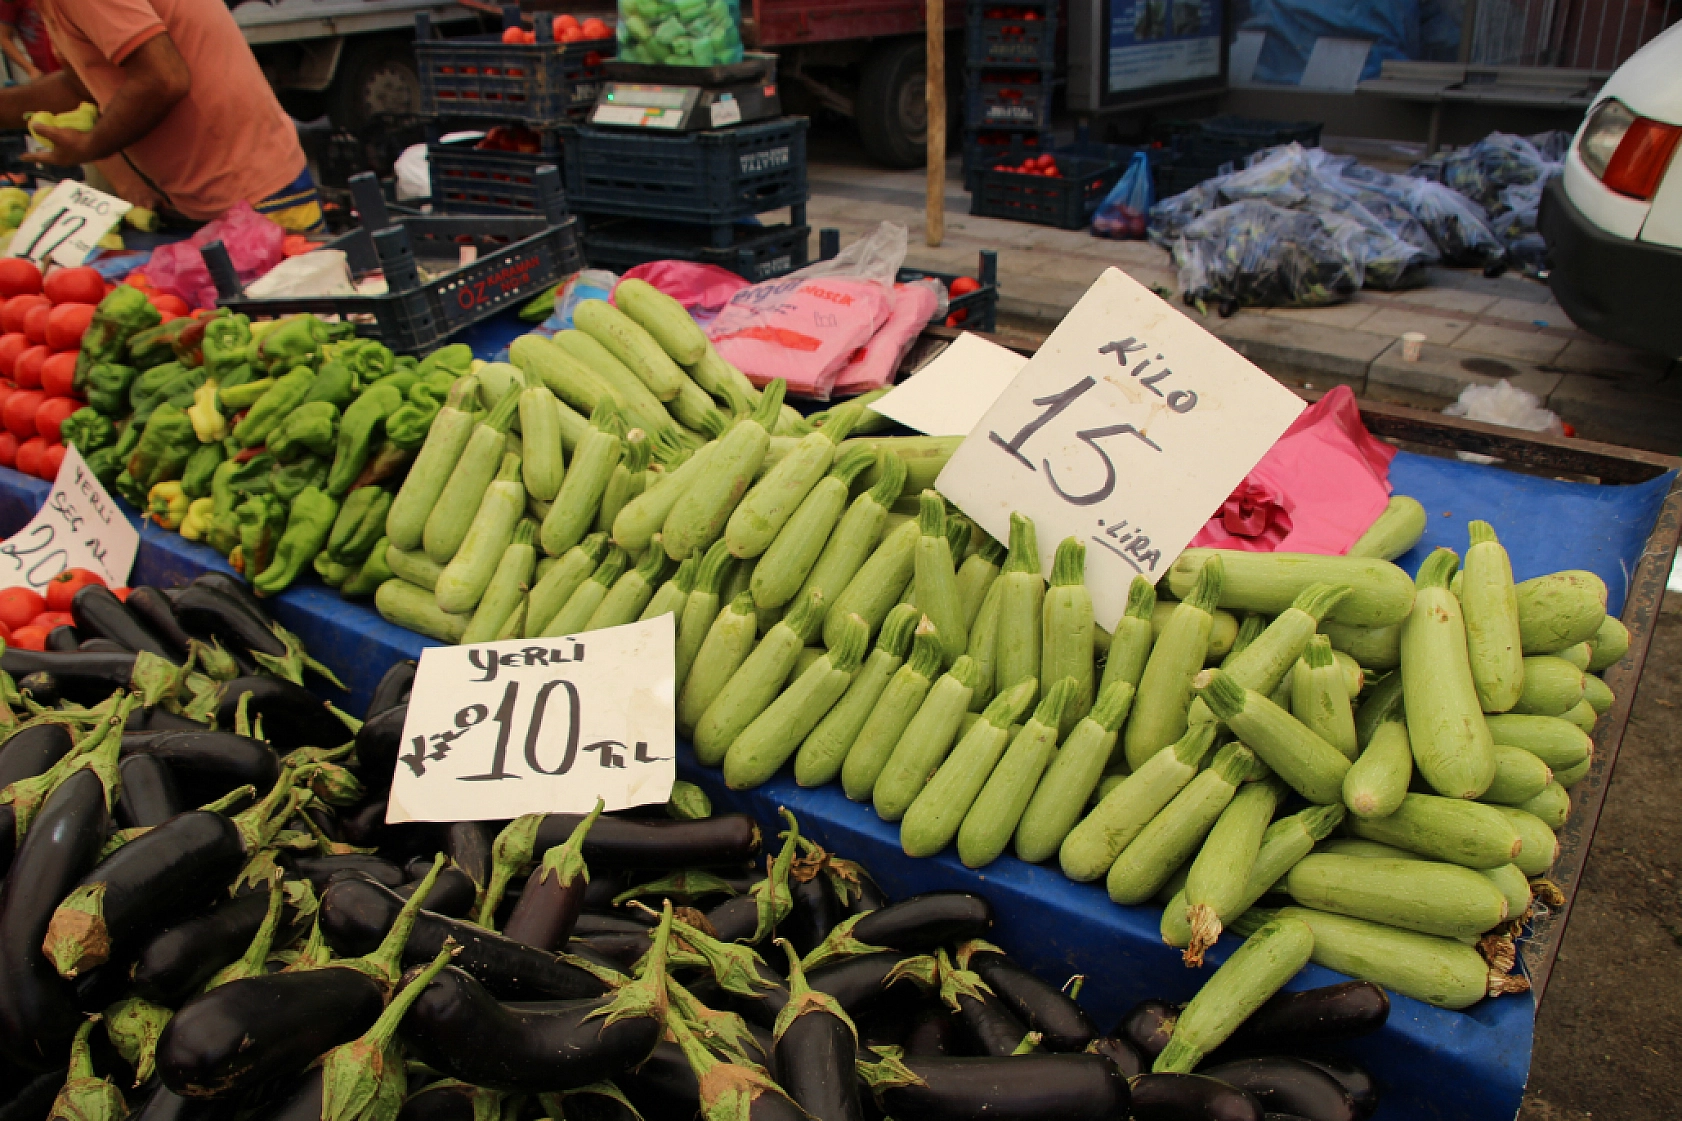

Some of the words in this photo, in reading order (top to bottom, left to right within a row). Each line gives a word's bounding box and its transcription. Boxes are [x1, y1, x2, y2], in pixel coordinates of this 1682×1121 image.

[14, 206, 88, 268] 12
[458, 281, 490, 310] ÖZ
[988, 375, 1163, 507] 15
[0, 523, 68, 588] 20
[456, 679, 582, 782] 10
